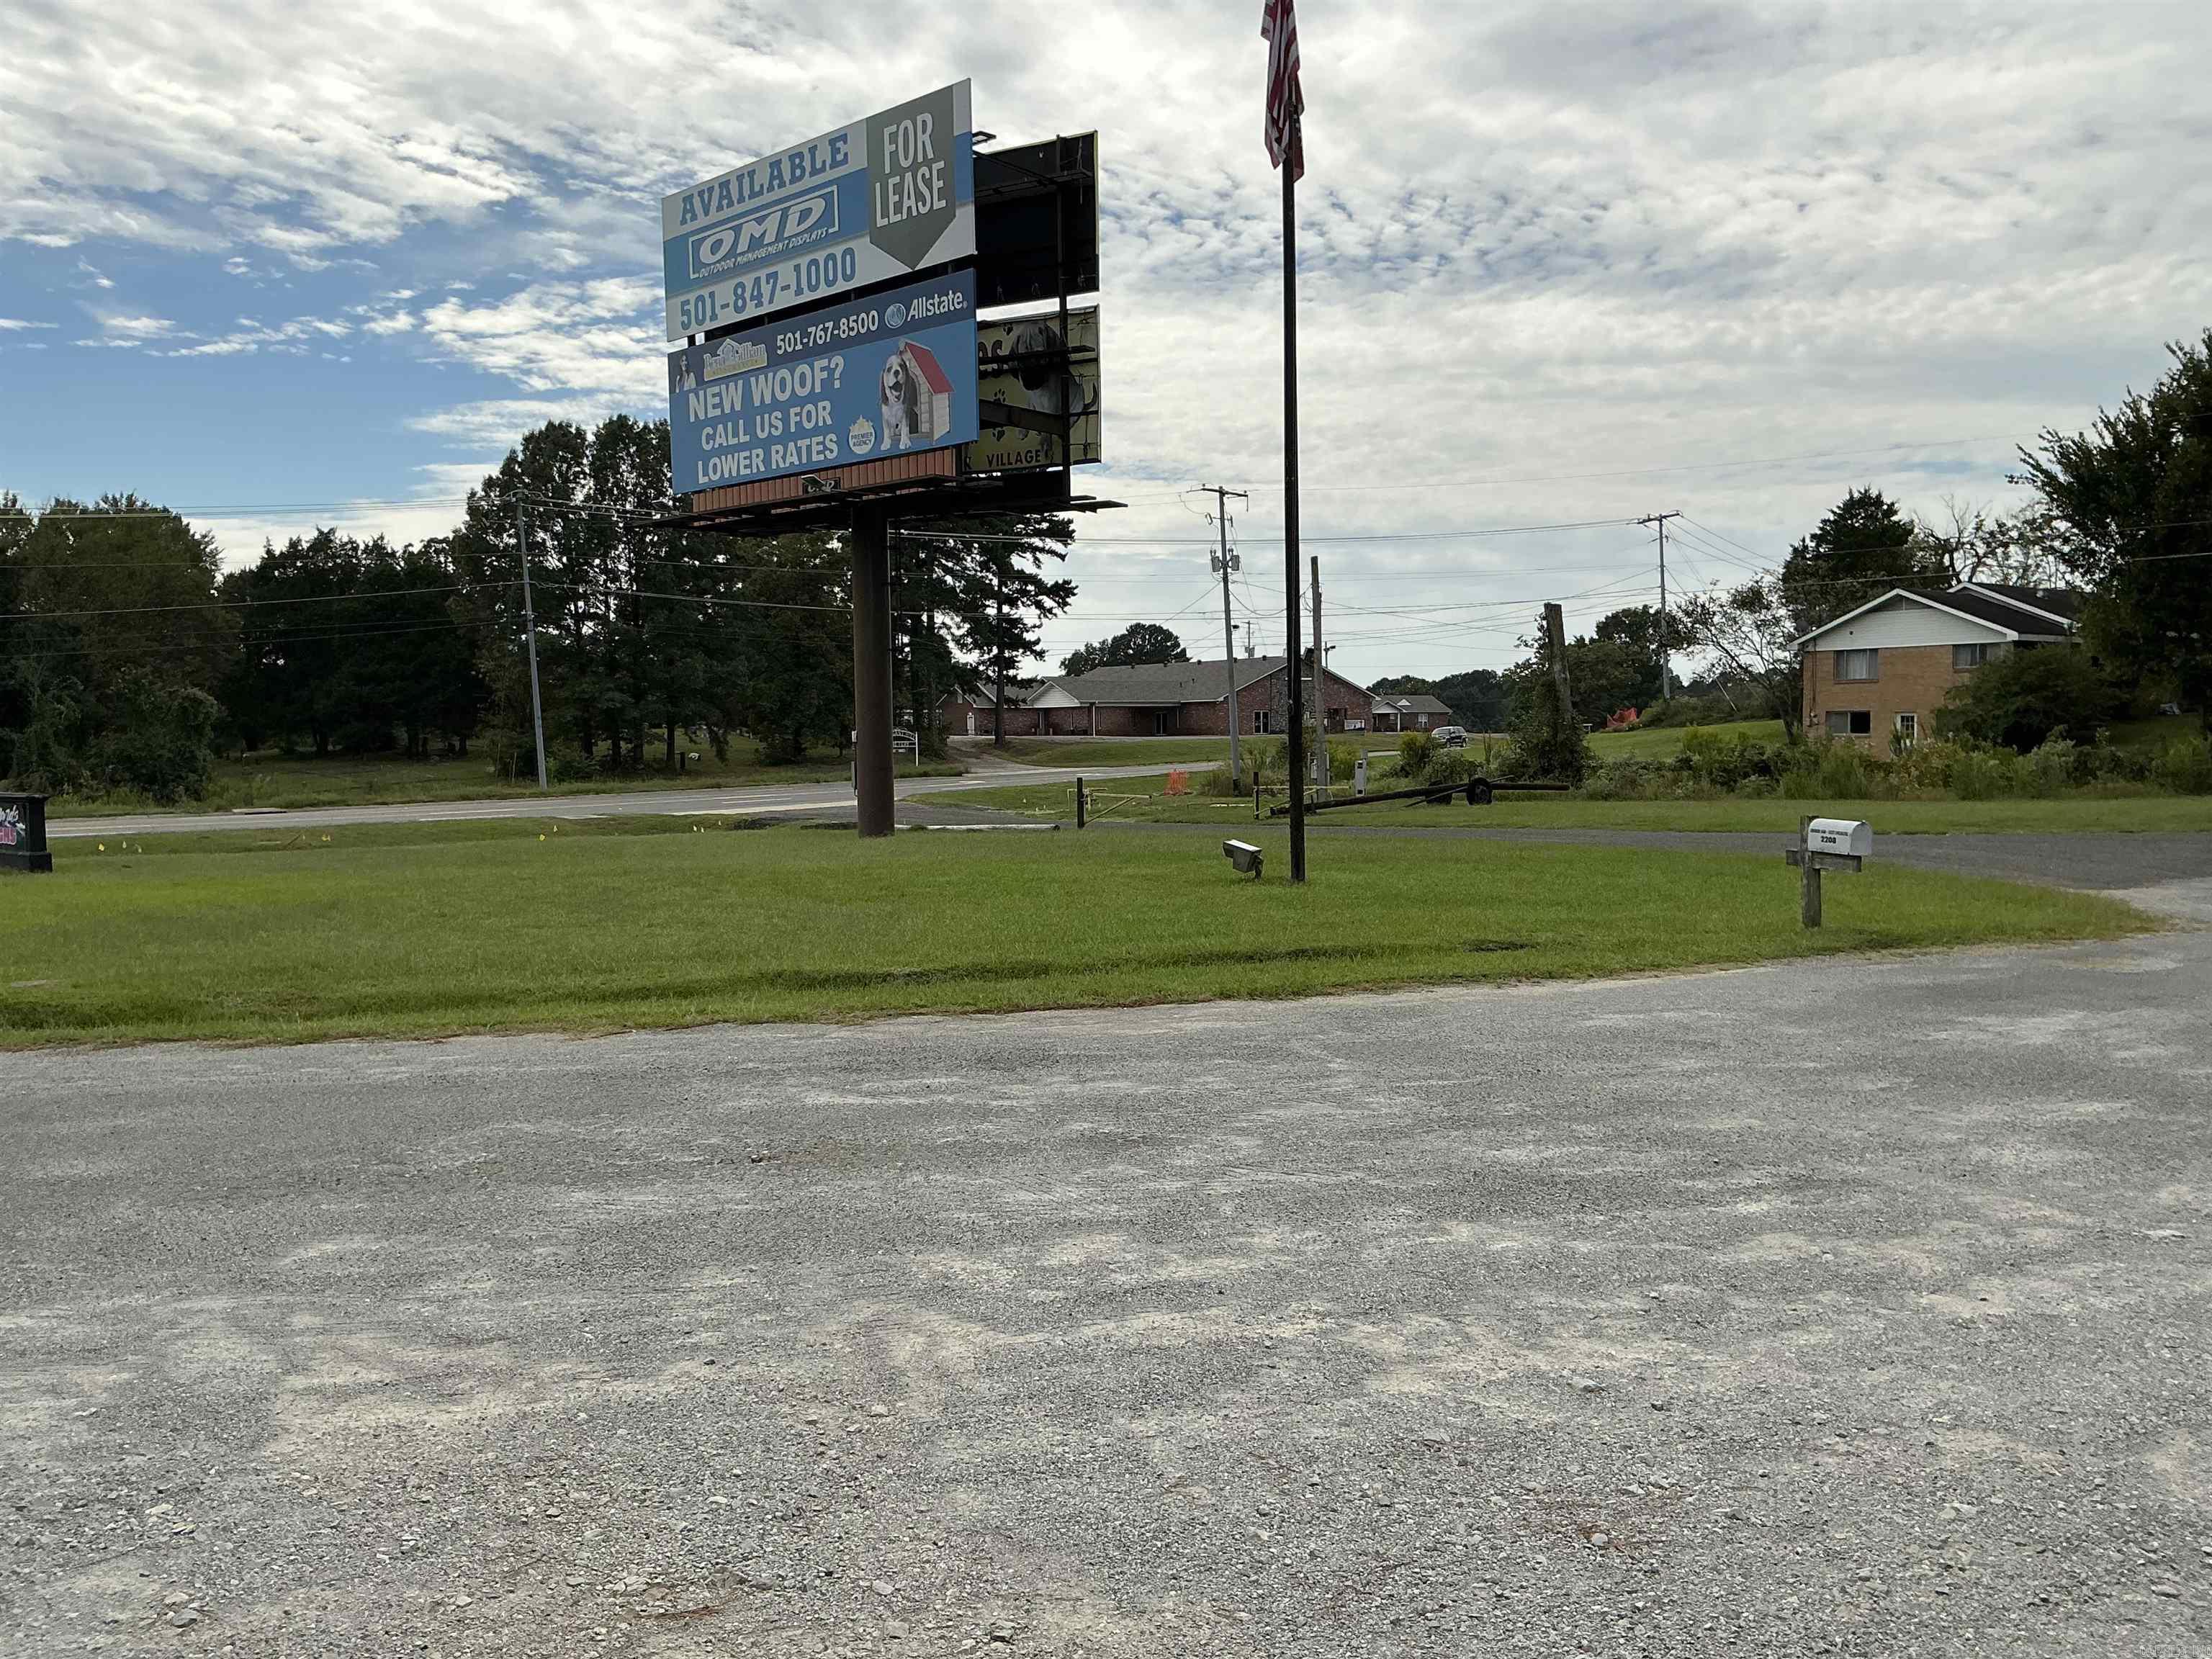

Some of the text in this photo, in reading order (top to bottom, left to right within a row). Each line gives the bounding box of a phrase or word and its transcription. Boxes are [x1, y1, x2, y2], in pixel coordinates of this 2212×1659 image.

[884, 113, 934, 174] FOR
[680, 132, 849, 225] AVAILABLE
[875, 161, 946, 228] LEASE
[698, 197, 827, 264] OMD
[700, 227, 828, 277] OUTDOOR MANAGEMENT DISPLAYS
[680, 246, 857, 331] 501-847-1000
[776, 310, 879, 355] 501-767-8500
[689, 356, 845, 423] NEW WOOF?
[701, 401, 832, 451] CALL US FOR
[850, 431, 873, 440] PREMIER
[698, 433, 839, 485] LOWER RATES
[986, 449, 1041, 467] VILLAGE
